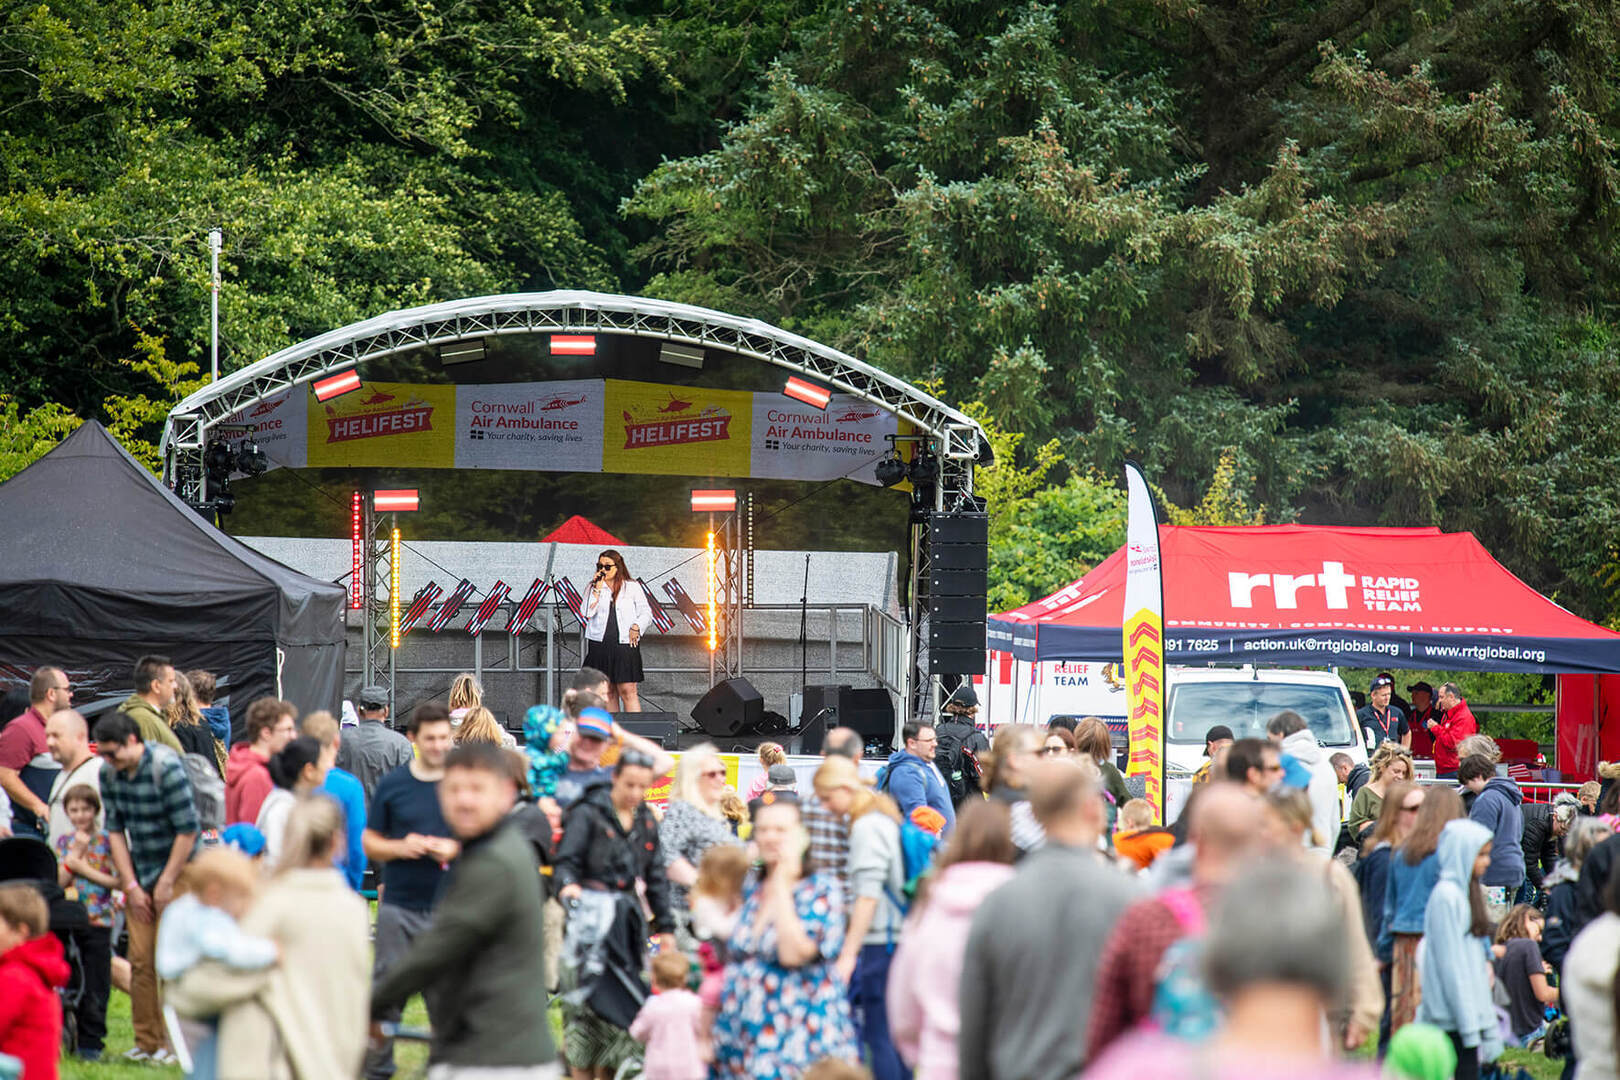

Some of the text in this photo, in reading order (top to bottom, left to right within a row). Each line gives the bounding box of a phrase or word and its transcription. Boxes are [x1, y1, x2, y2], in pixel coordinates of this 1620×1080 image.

[471, 400, 535, 414] Cornwall
[470, 415, 579, 430] Air Ambulance
[767, 409, 830, 425] Cornwall
[334, 412, 427, 438] HELIFEST
[631, 421, 725, 444] HELIFEST
[487, 431, 505, 440] Your
[538, 433, 564, 443] saving
[565, 431, 583, 442] lives
[765, 425, 873, 443] Air Ambulance
[782, 441, 800, 450] Your
[833, 445, 858, 456] saving
[859, 446, 876, 456] lives
[1228, 561, 1356, 609] rrt
[1361, 575, 1420, 590] RAPID
[1363, 588, 1420, 602] RELIEF
[1364, 601, 1422, 612] TEAM
[1187, 639, 1219, 651] 7625
[1244, 638, 1400, 656] action.uk@rrtglobal.org
[1424, 645, 1545, 662] www.rrtglobal.org
[1054, 664, 1089, 674] RELIEF
[1054, 676, 1089, 686] TEAM
